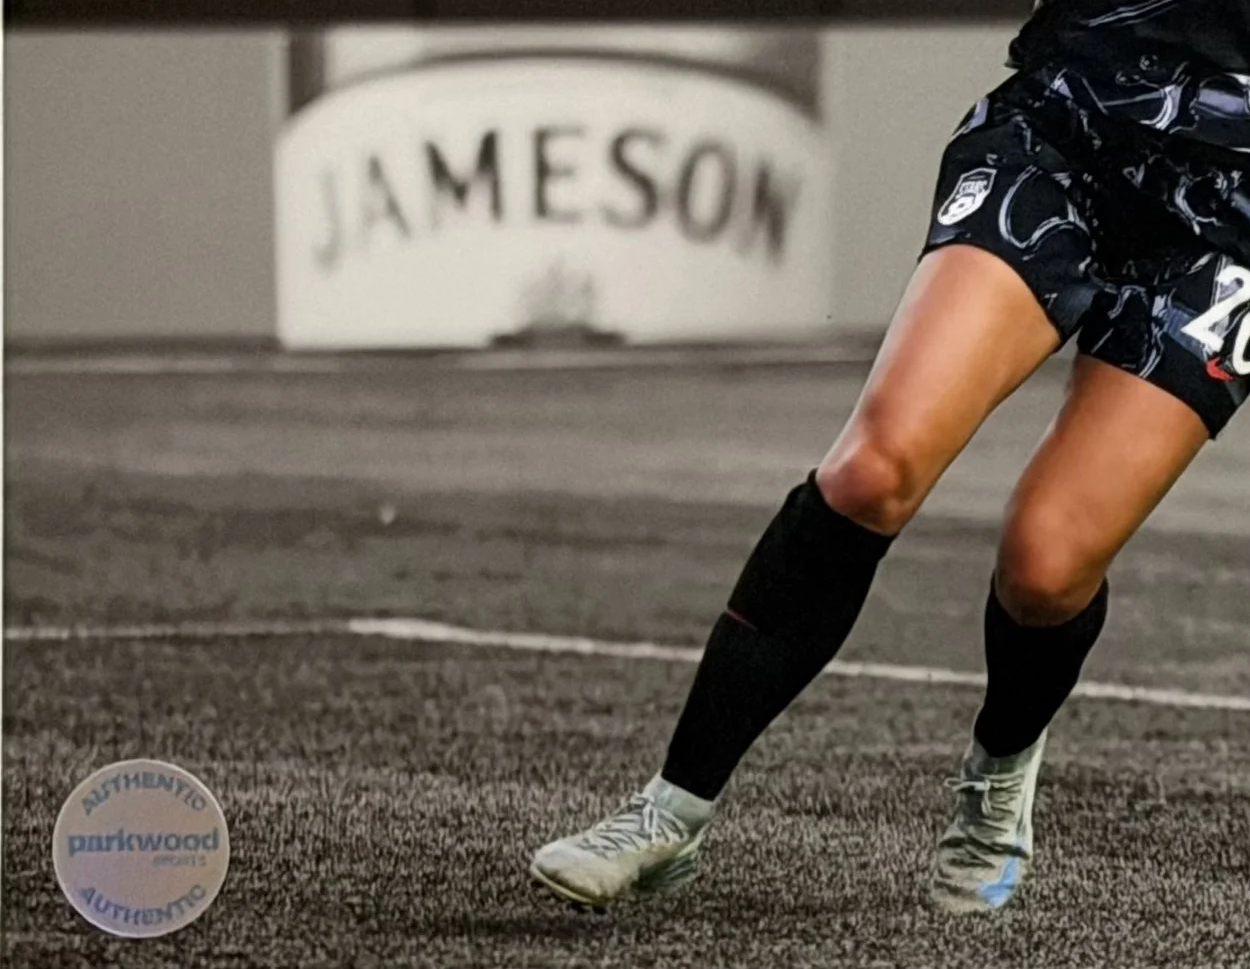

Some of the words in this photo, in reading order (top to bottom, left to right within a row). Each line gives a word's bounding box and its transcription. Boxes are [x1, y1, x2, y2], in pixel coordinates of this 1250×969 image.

[312, 127, 800, 273] JAMESON
[82, 771, 208, 817] AUTHENTIC
[67, 828, 220, 857] parkwood
[80, 884, 207, 926] AUTHENTIC
